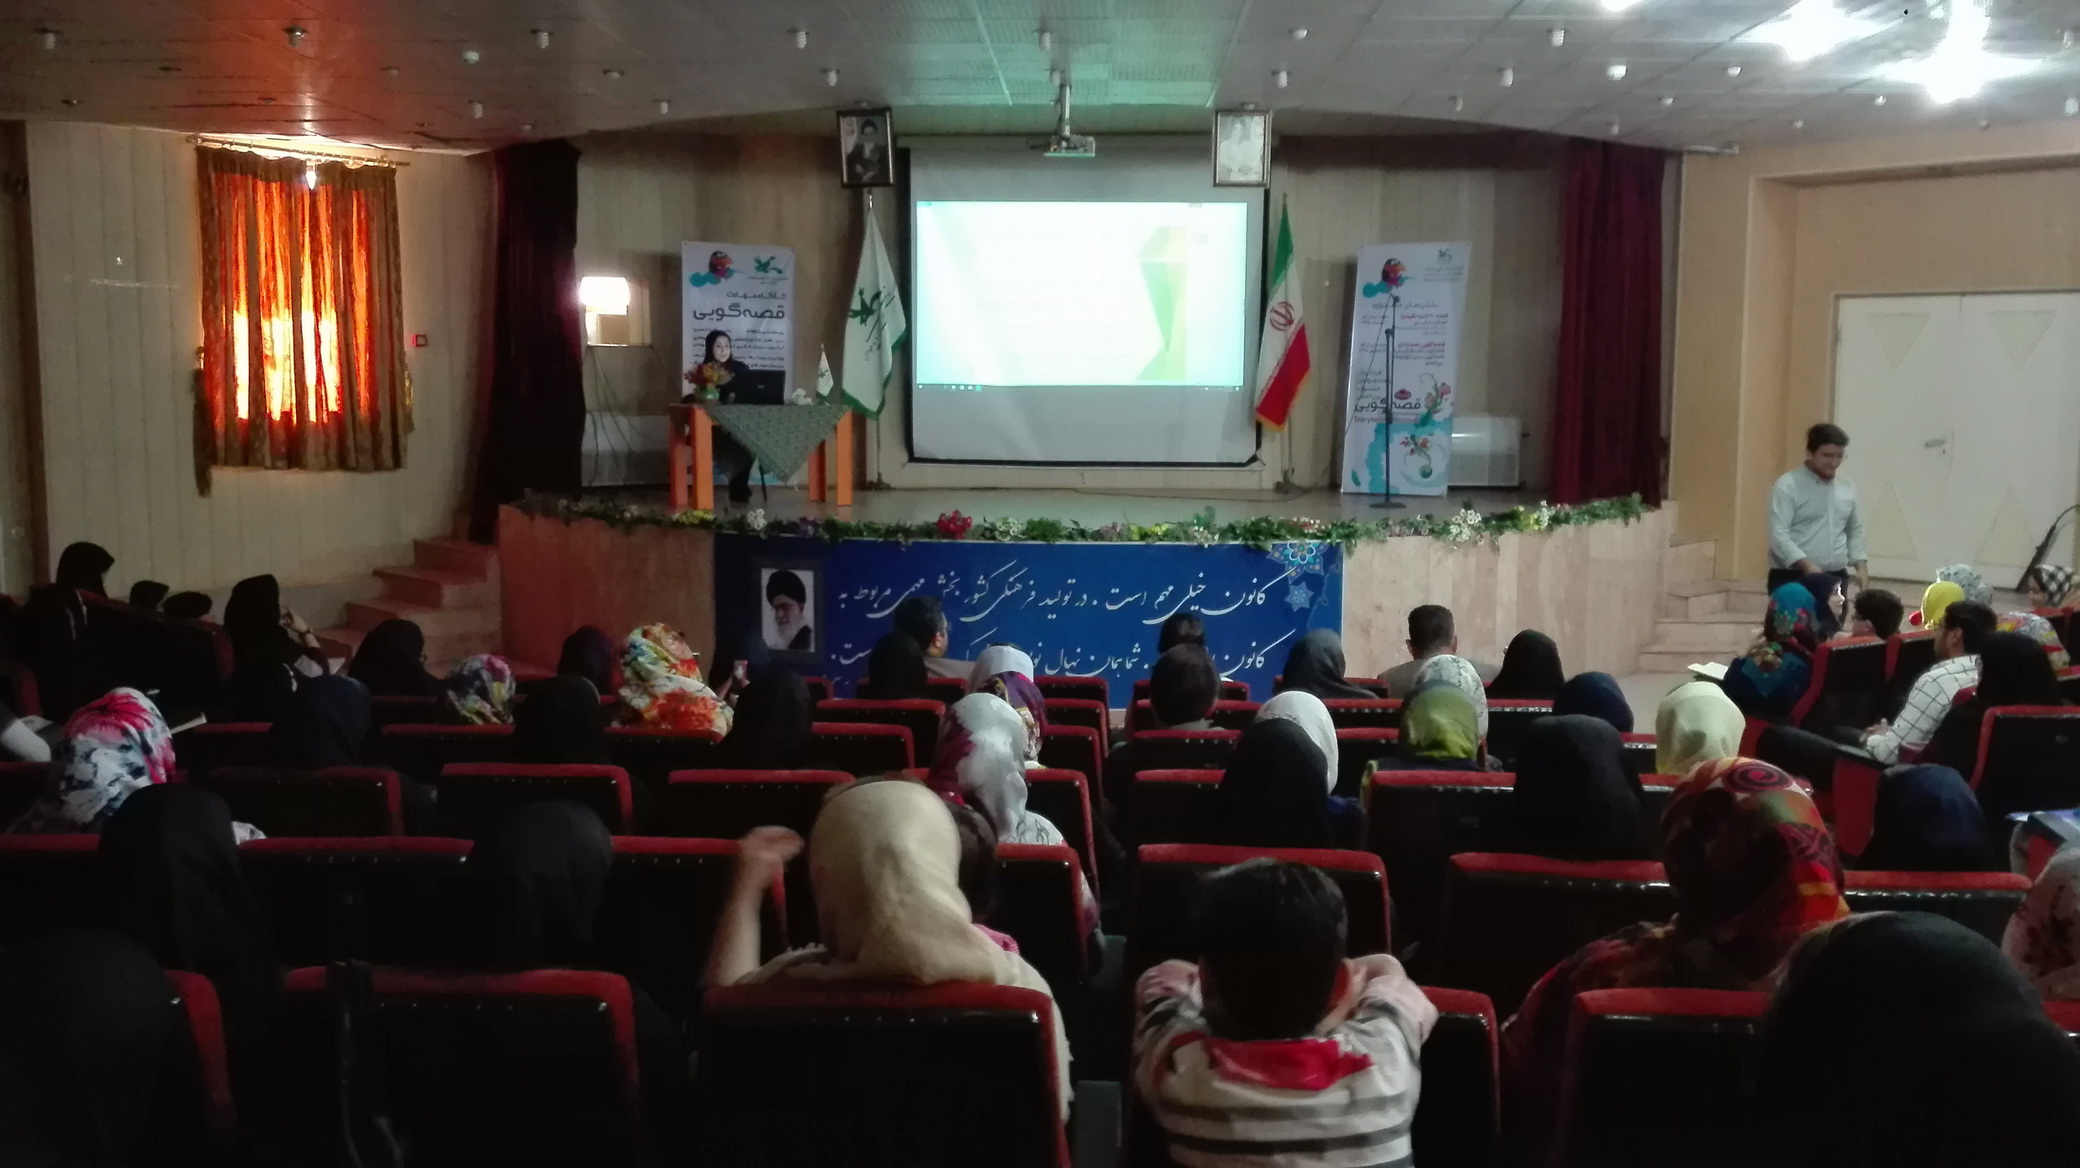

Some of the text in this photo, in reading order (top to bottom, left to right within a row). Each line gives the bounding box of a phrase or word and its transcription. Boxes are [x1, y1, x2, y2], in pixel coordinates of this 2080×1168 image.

[854, 585, 892, 608] مربوط
[937, 570, 961, 596] بخش
[964, 559, 1018, 604] کشور
[1155, 585, 1174, 609] مهم
[1200, 566, 1297, 616] کانون
[838, 591, 848, 609] به
[866, 578, 926, 619] مهمی
[1038, 578, 1077, 620] تولید
[1075, 593, 1088, 608] در
[1142, 572, 1206, 625] خیلی
